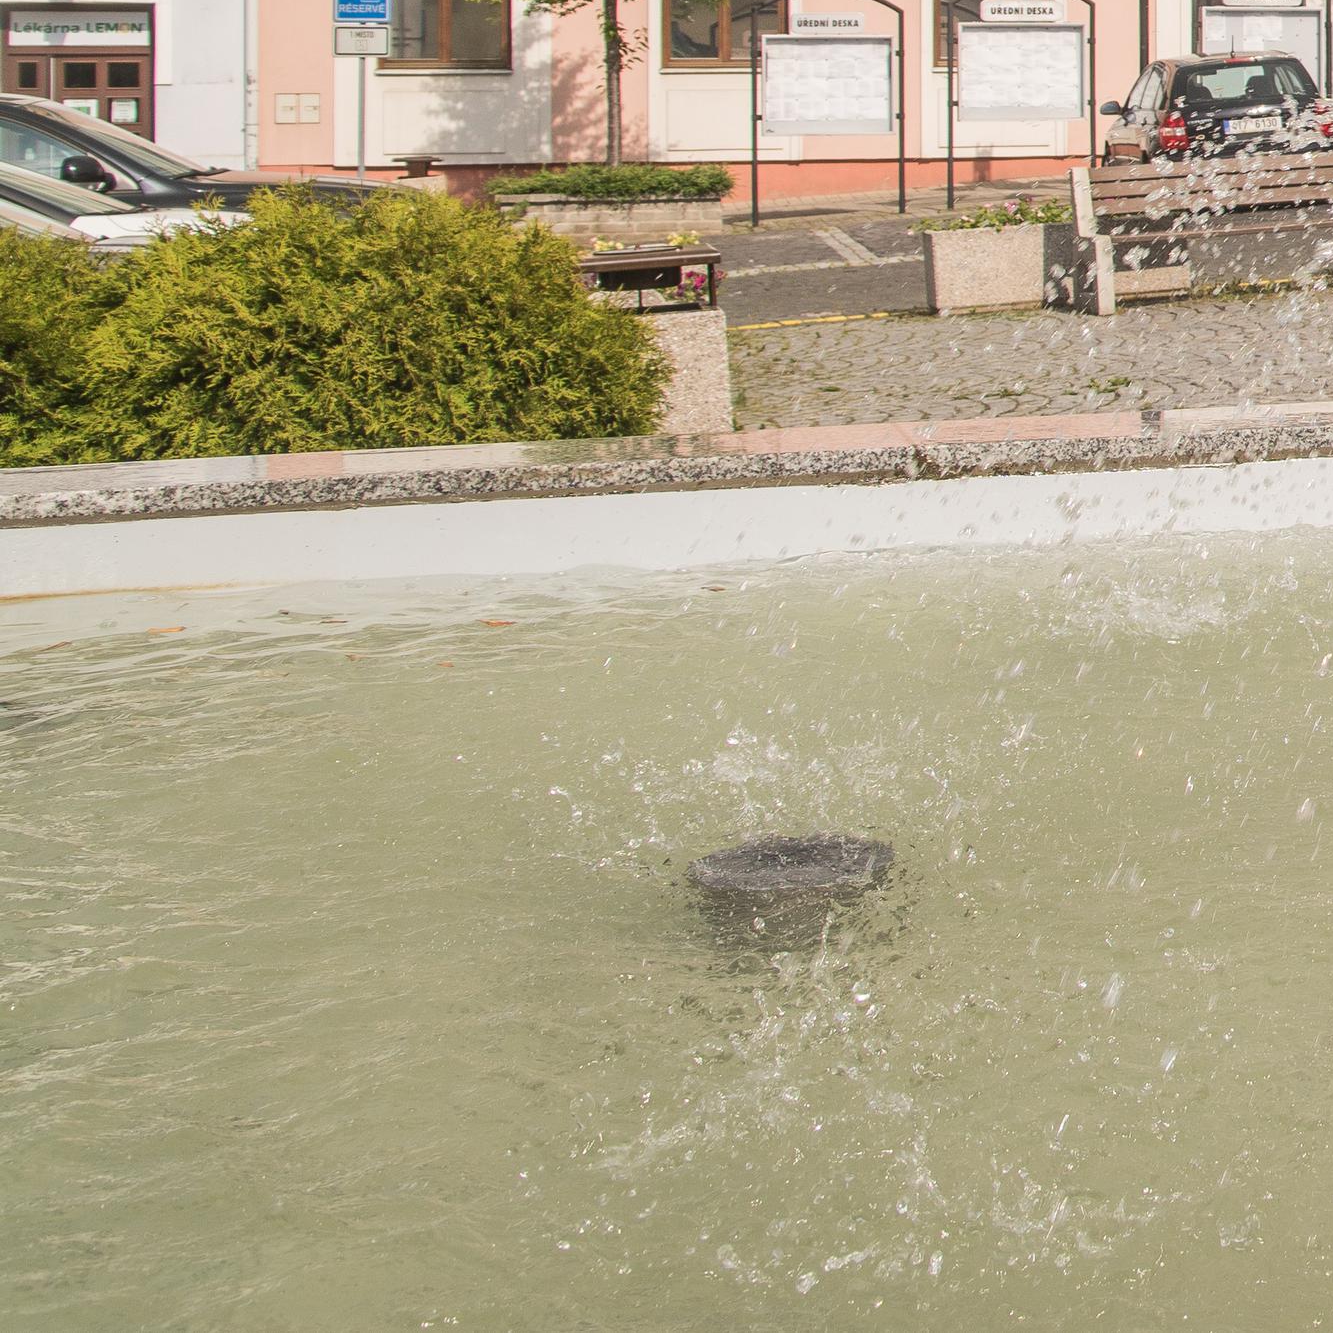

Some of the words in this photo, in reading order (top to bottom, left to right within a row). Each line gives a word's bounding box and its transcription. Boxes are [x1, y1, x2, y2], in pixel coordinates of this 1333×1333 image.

[338, 3, 386, 13] RÉSERVÉ
[1026, 6, 1054, 15] DESKA
[13, 21, 80, 33] Lékárna
[86, 22, 143, 34] LEMON
[797, 17, 829, 28] ÚŘEDNÍ
[832, 19, 859, 28] DESKA
[1254, 118, 1278, 129] 6130
